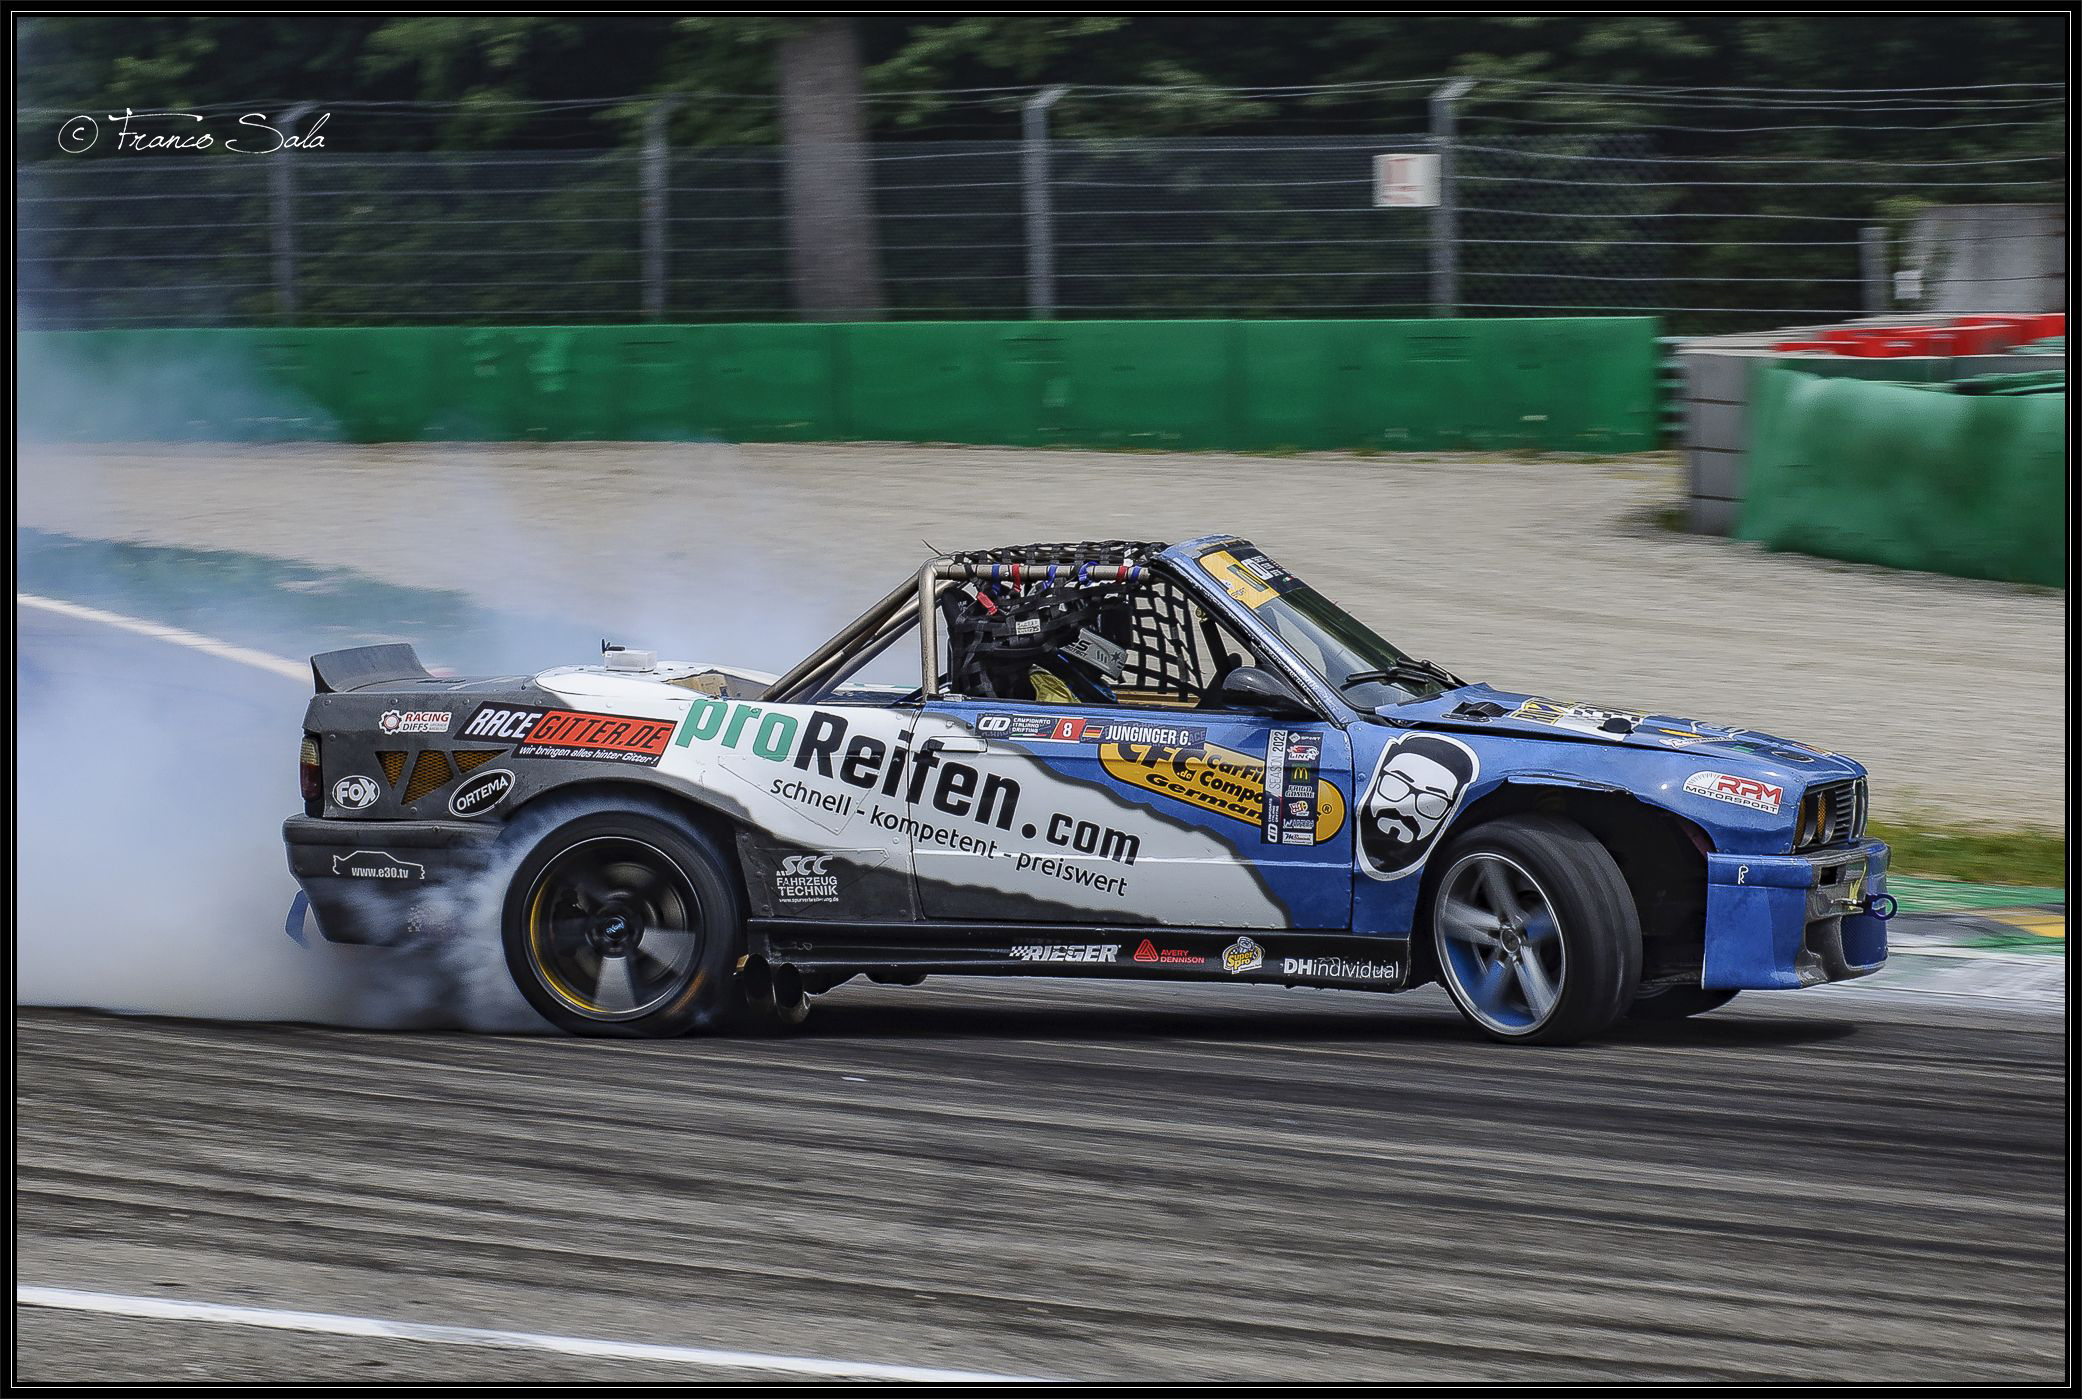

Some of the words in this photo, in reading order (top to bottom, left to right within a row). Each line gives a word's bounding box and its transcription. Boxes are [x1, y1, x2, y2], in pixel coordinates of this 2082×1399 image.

[405, 713, 449, 722] RACING
[1013, 717, 1051, 725] CAMPIONATO
[403, 723, 429, 731] DIFFS
[1062, 722, 1073, 738] 8
[1106, 725, 1176, 745] JUNGINGER
[1180, 729, 1192, 746] G.
[1272, 731, 1286, 753] 2022
[519, 744, 536, 755] wir
[535, 745, 571, 758] bringen
[570, 748, 593, 758] alles
[592, 749, 622, 760] hinter
[1269, 756, 1283, 790] SEASON
[456, 776, 509, 811] ORTEMA
[1685, 785, 1778, 812] MOTORSPORT
[1717, 775, 1782, 805] RPM
[770, 778, 852, 816] schnell
[869, 804, 998, 860] kompetent
[1015, 852, 1128, 896] preiswert
[351, 866, 409, 879] www.e30.tv
[782, 855, 833, 876] SCC
[776, 876, 838, 886] FAHRZEUG
[777, 885, 838, 897] TECHNIK
[1021, 944, 1118, 963] RIEGER
[1160, 956, 1205, 964] DENNISON
